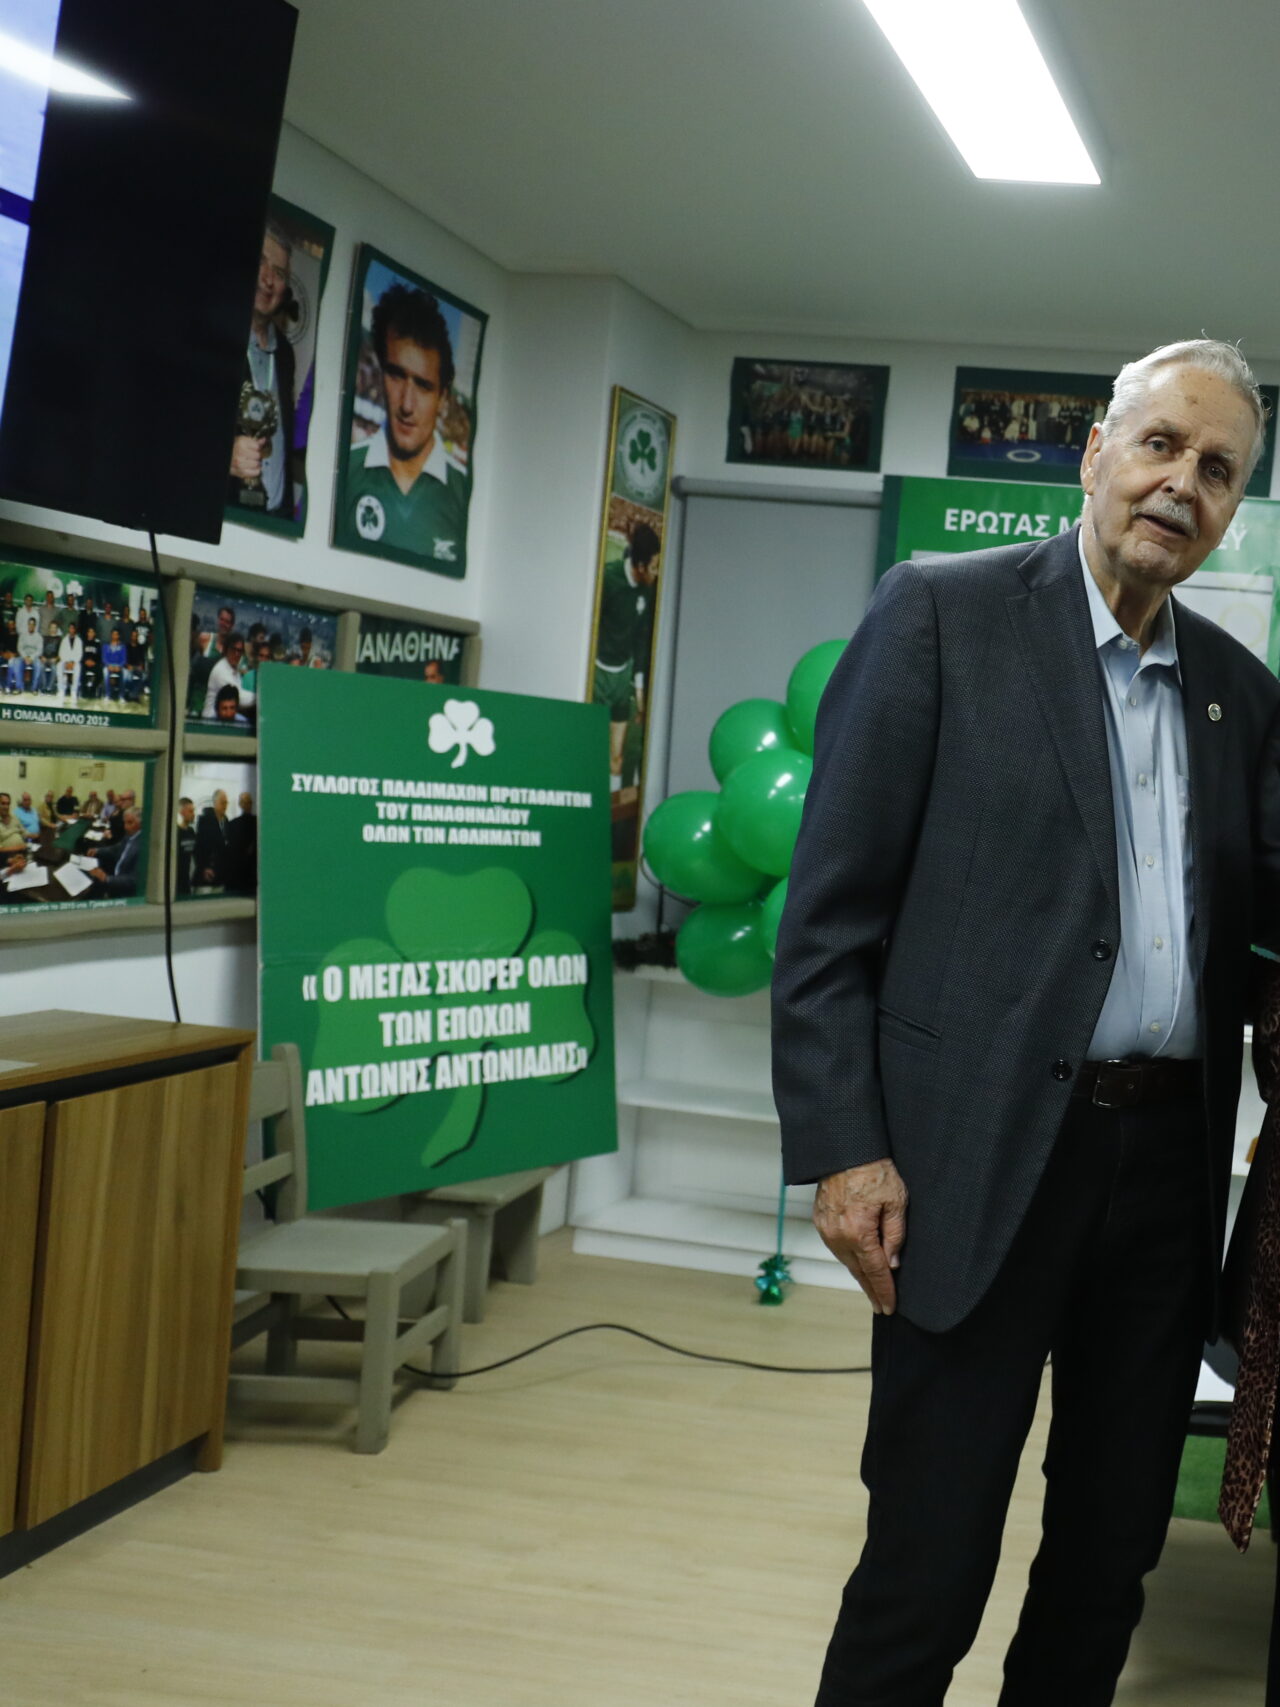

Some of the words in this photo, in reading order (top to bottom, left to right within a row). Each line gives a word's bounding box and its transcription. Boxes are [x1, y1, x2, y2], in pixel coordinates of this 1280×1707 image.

[943, 507, 1051, 538] ΕΡΩΤΑΣ
[2, 708, 11, 719] Η
[13, 709, 52, 722] ΟΜΑΔΑ
[55, 712, 85, 725] ΠΟΛΟ
[86, 714, 110, 727] 2012
[291, 773, 380, 796] ΣΥΛΛΟΓΟΣ
[382, 779, 488, 803] ΠΑΛΑΙΜΑΧΩΝ
[490, 786, 593, 808] ΠΡΩΤΑΘΛΗΤΩΝ
[376, 801, 409, 820] ΤΟΥ
[411, 804, 530, 825] ΠΑΝΑΘΗΝΑΪΚΟΥ
[362, 824, 410, 843] ΟΛΩΝ
[412, 826, 446, 844] ΤΩΝ
[448, 828, 542, 847] ΑΘΛΗΜΑΤΩΝ
[349, 961, 432, 1000] ΜΕΓΑΣ
[435, 957, 525, 995] ΣΚΟΡΕΡ
[527, 953, 588, 989] ΟΛΩΝ
[379, 1009, 432, 1047] ΤΩΝ
[437, 1001, 531, 1042] ΕΠΟΧΩΝ
[305, 1057, 432, 1106] ΑΝΤΩΝΗΣ
